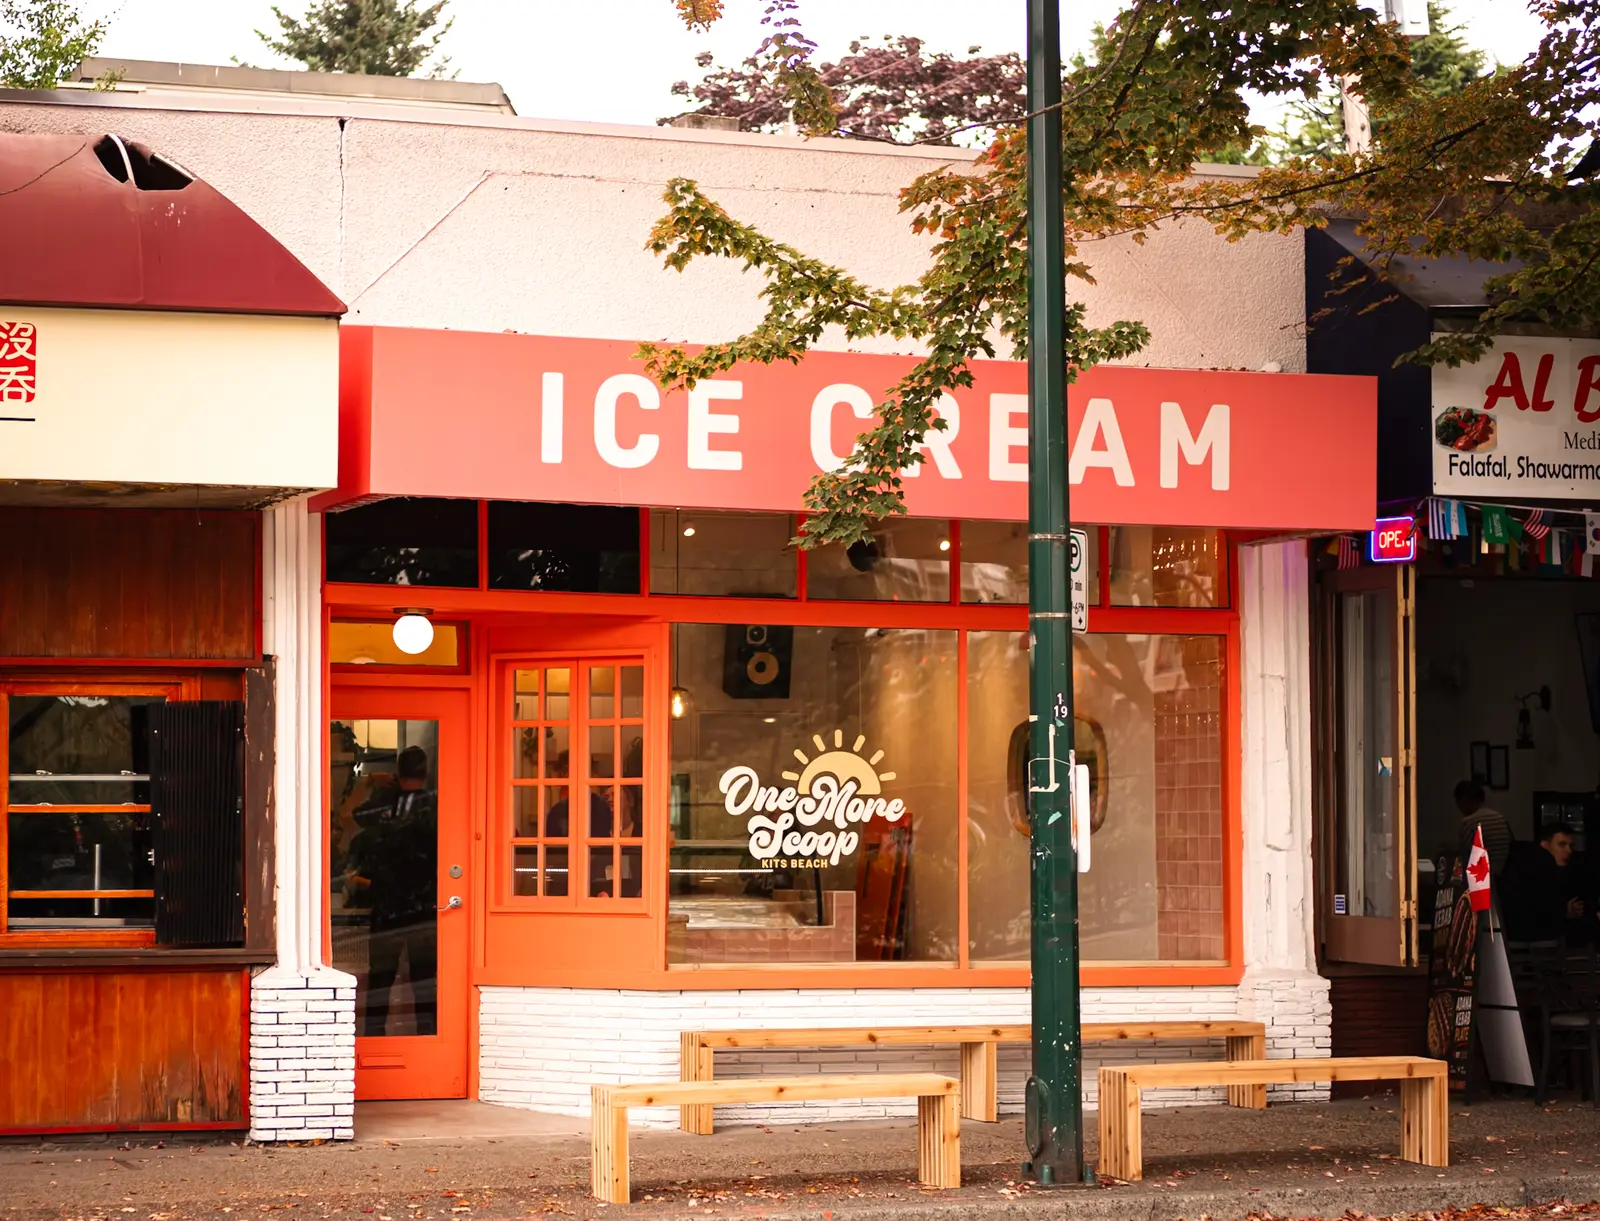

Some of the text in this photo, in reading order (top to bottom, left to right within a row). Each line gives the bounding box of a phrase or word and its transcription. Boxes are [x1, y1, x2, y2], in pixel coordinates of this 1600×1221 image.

[1483, 352, 1555, 412] AL
[540, 371, 1231, 491] ICE CREAM
[1449, 454, 1512, 480] Falafal,
[1053, 705, 1068, 718] 19
[1056, 692, 1063, 705] 1
[719, 765, 906, 829] One More
[747, 812, 859, 866] Scoop
[761, 859, 828, 868] KITS BEACH
